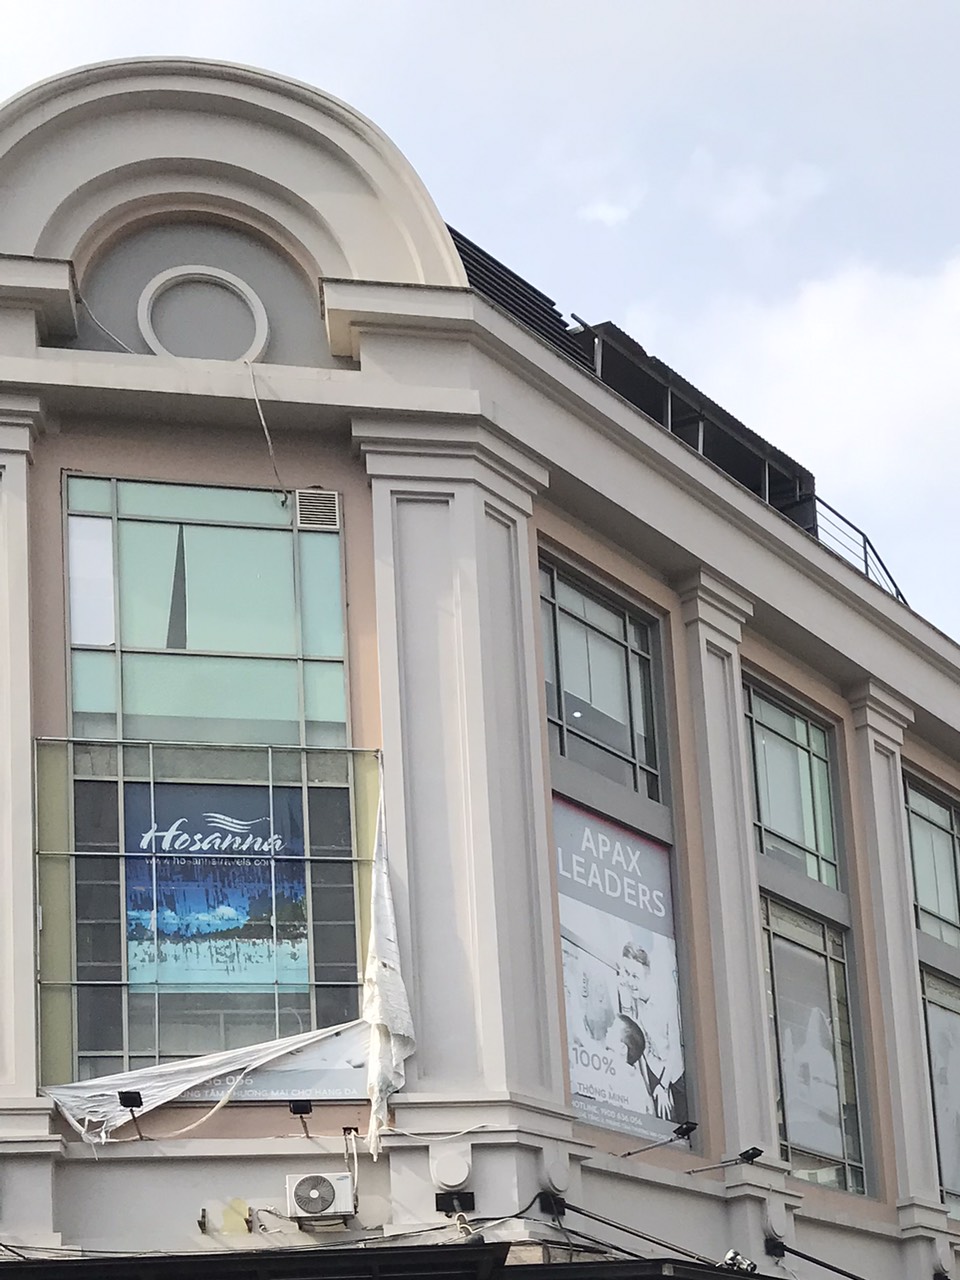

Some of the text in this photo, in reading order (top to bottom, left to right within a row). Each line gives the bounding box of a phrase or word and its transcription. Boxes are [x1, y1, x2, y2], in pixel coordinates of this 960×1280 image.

[140, 818, 287, 851] Hosanna
[581, 827, 641, 876] APAX
[558, 847, 665, 917] LEADERS
[572, 1047, 616, 1076] 100%
